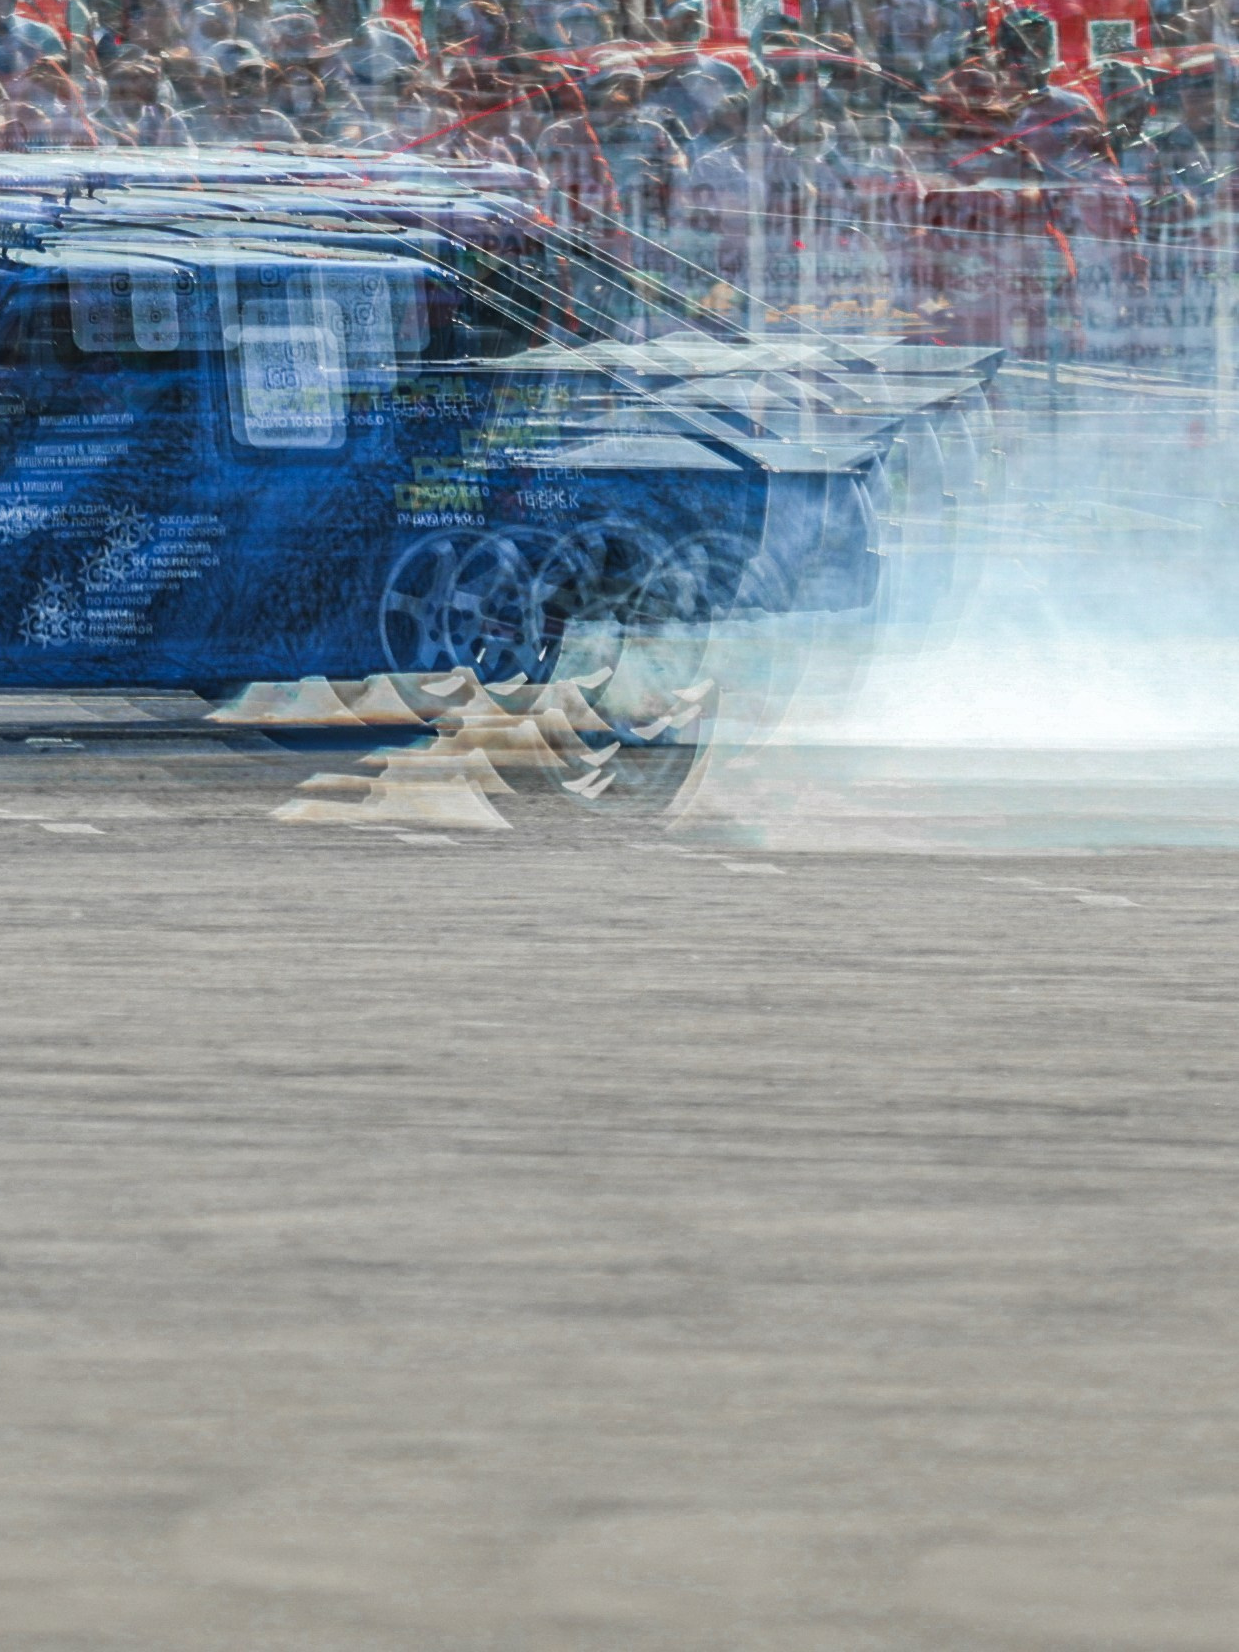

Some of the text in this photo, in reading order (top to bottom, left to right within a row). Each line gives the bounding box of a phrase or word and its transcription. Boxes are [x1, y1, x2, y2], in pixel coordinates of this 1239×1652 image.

[159, 515, 218, 525] ОХЛАДИМ
[159, 525, 226, 536] ПО ПОЛНОЙ
